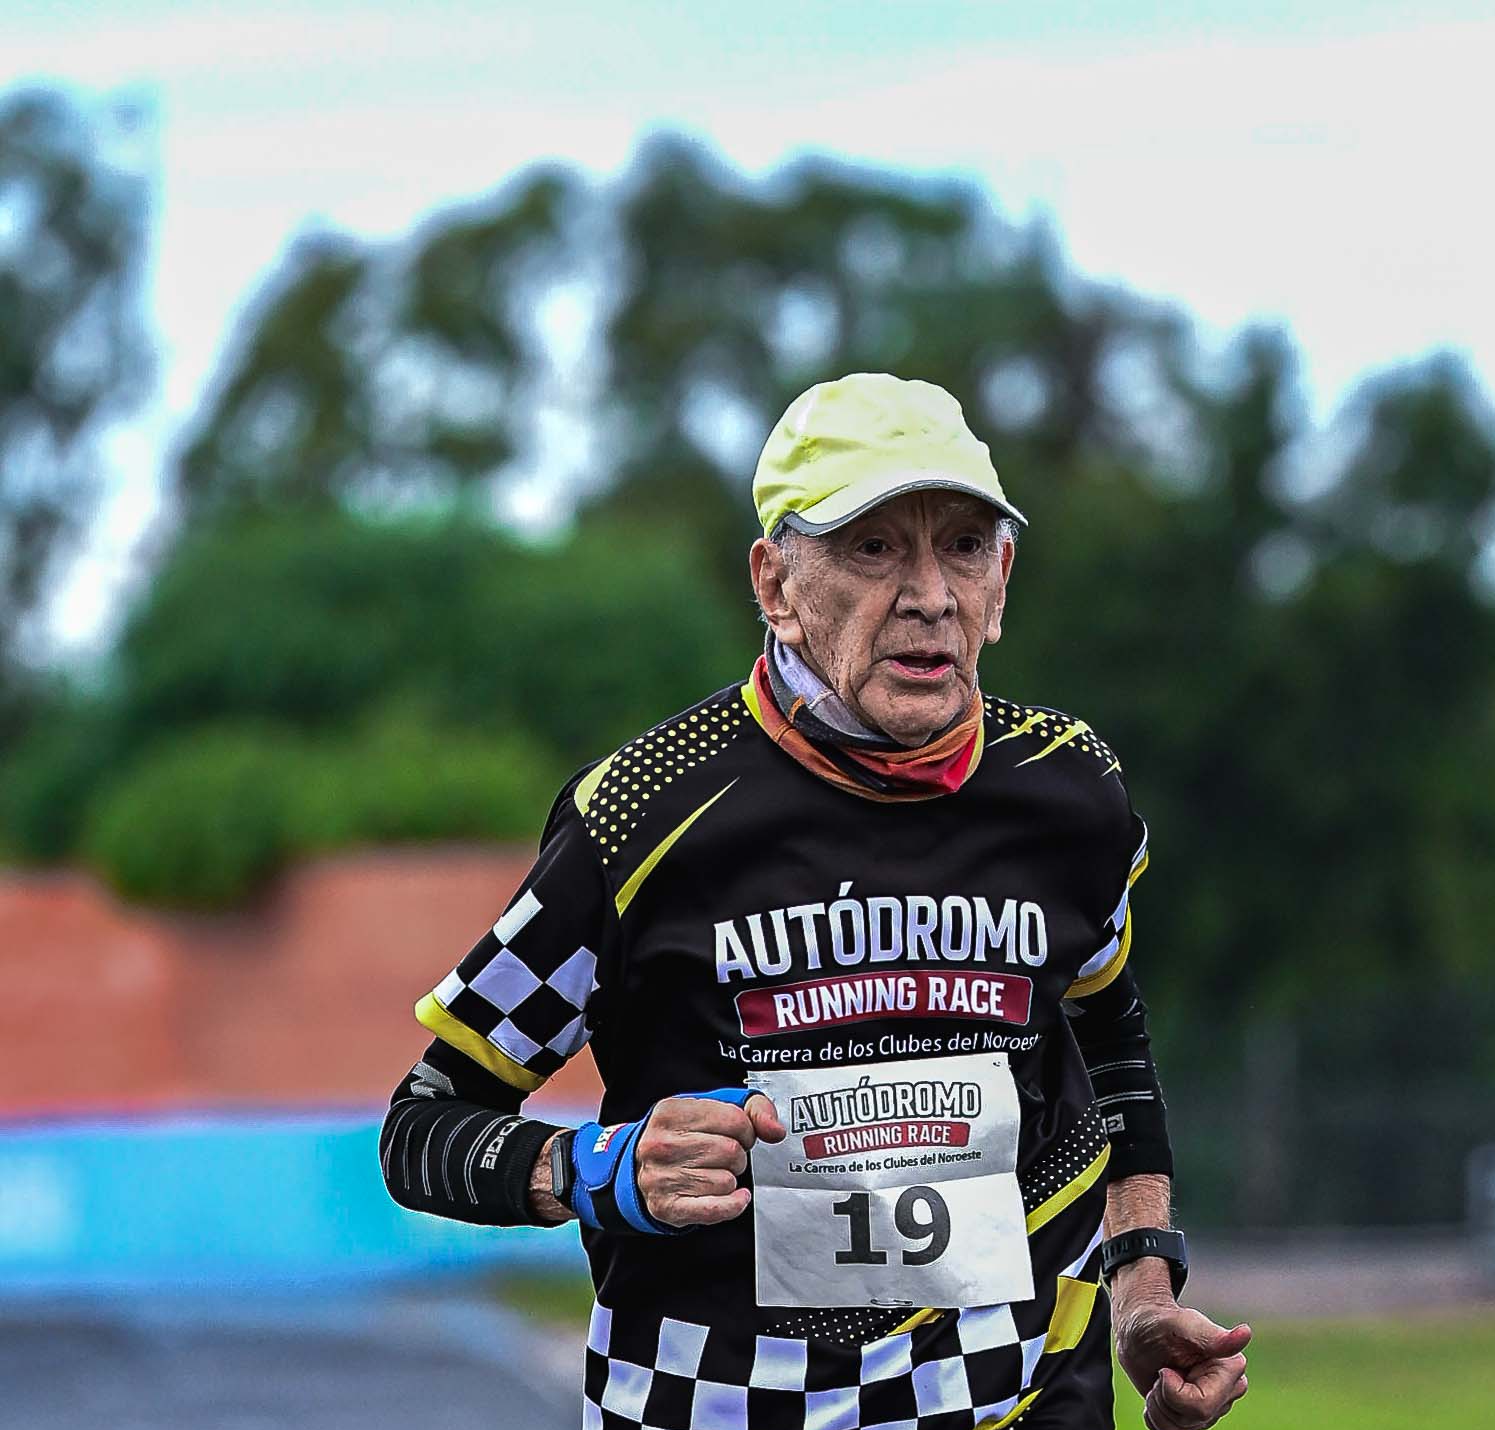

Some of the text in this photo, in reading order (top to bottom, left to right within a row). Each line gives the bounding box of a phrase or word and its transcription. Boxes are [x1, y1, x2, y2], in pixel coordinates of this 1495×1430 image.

[713, 881, 1048, 984] AUTÓDROMO
[773, 976, 1005, 1029] RUNNING RACE
[718, 1039, 737, 1060] La
[739, 1044, 812, 1063] Carrera
[819, 1042, 843, 1061] de
[848, 1039, 874, 1058] los
[879, 1034, 942, 1055] Clubes
[948, 1032, 978, 1051] del
[791, 1075, 982, 1133] AUTÓDROMO
[789, 1150, 982, 1174] La Carrera de los Clubes del Noroeste
[823, 1124, 952, 1155] RUNNING RACE
[832, 1185, 952, 1266] 19
